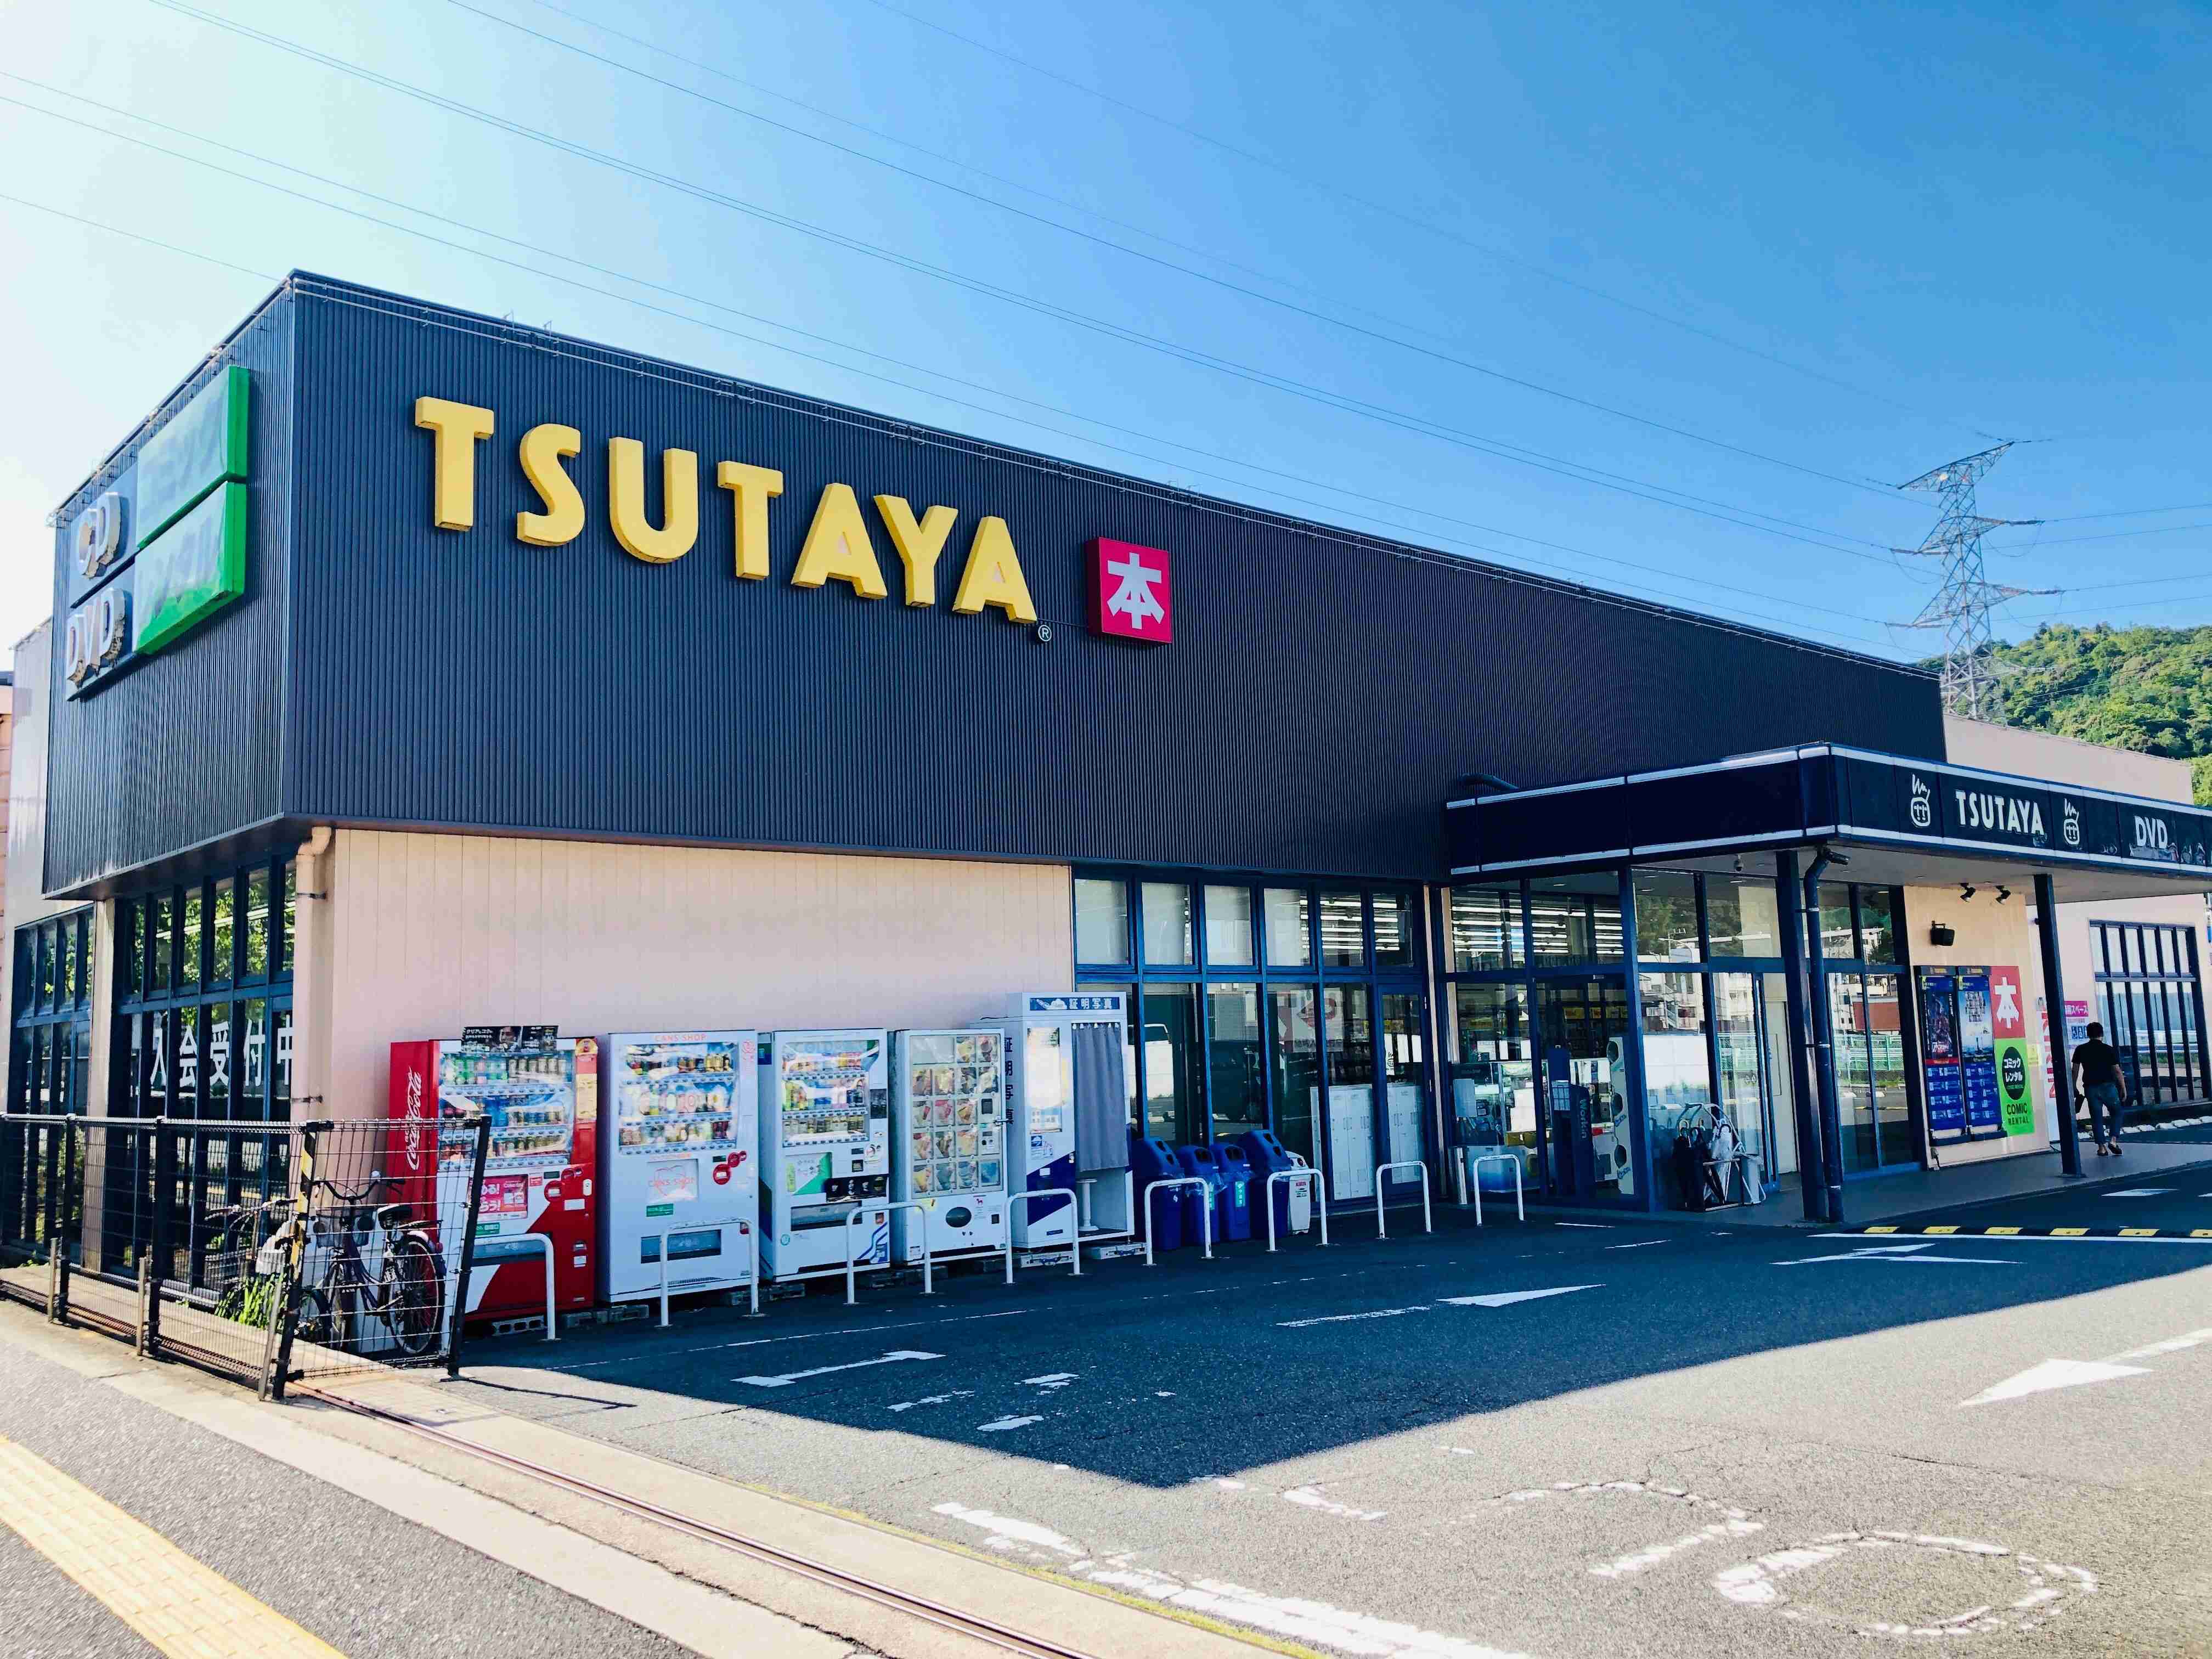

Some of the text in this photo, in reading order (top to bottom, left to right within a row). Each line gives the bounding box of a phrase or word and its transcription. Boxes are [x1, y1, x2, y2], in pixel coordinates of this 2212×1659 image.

[415, 396, 1037, 624] TSUTAYA
[77, 492, 122, 579] CD
[1107, 553, 1164, 629] 本
[66, 588, 125, 688] DVD
[1955, 790, 2045, 836] TSUTAYA
[2134, 815, 2168, 849] DVD
[1069, 998, 1112, 1009] 証明写真
[1995, 977, 2019, 1029] 本
[150, 1014, 294, 1087] 入会受付中
[2004, 1057, 2021, 1069] コミック
[2005, 1071, 2023, 1082] レンタル
[407, 1066, 421, 1171] Coca-Cola
[2007, 1103, 2028, 1115] COMIC
[2008, 1116, 2029, 1125] RENTAL
